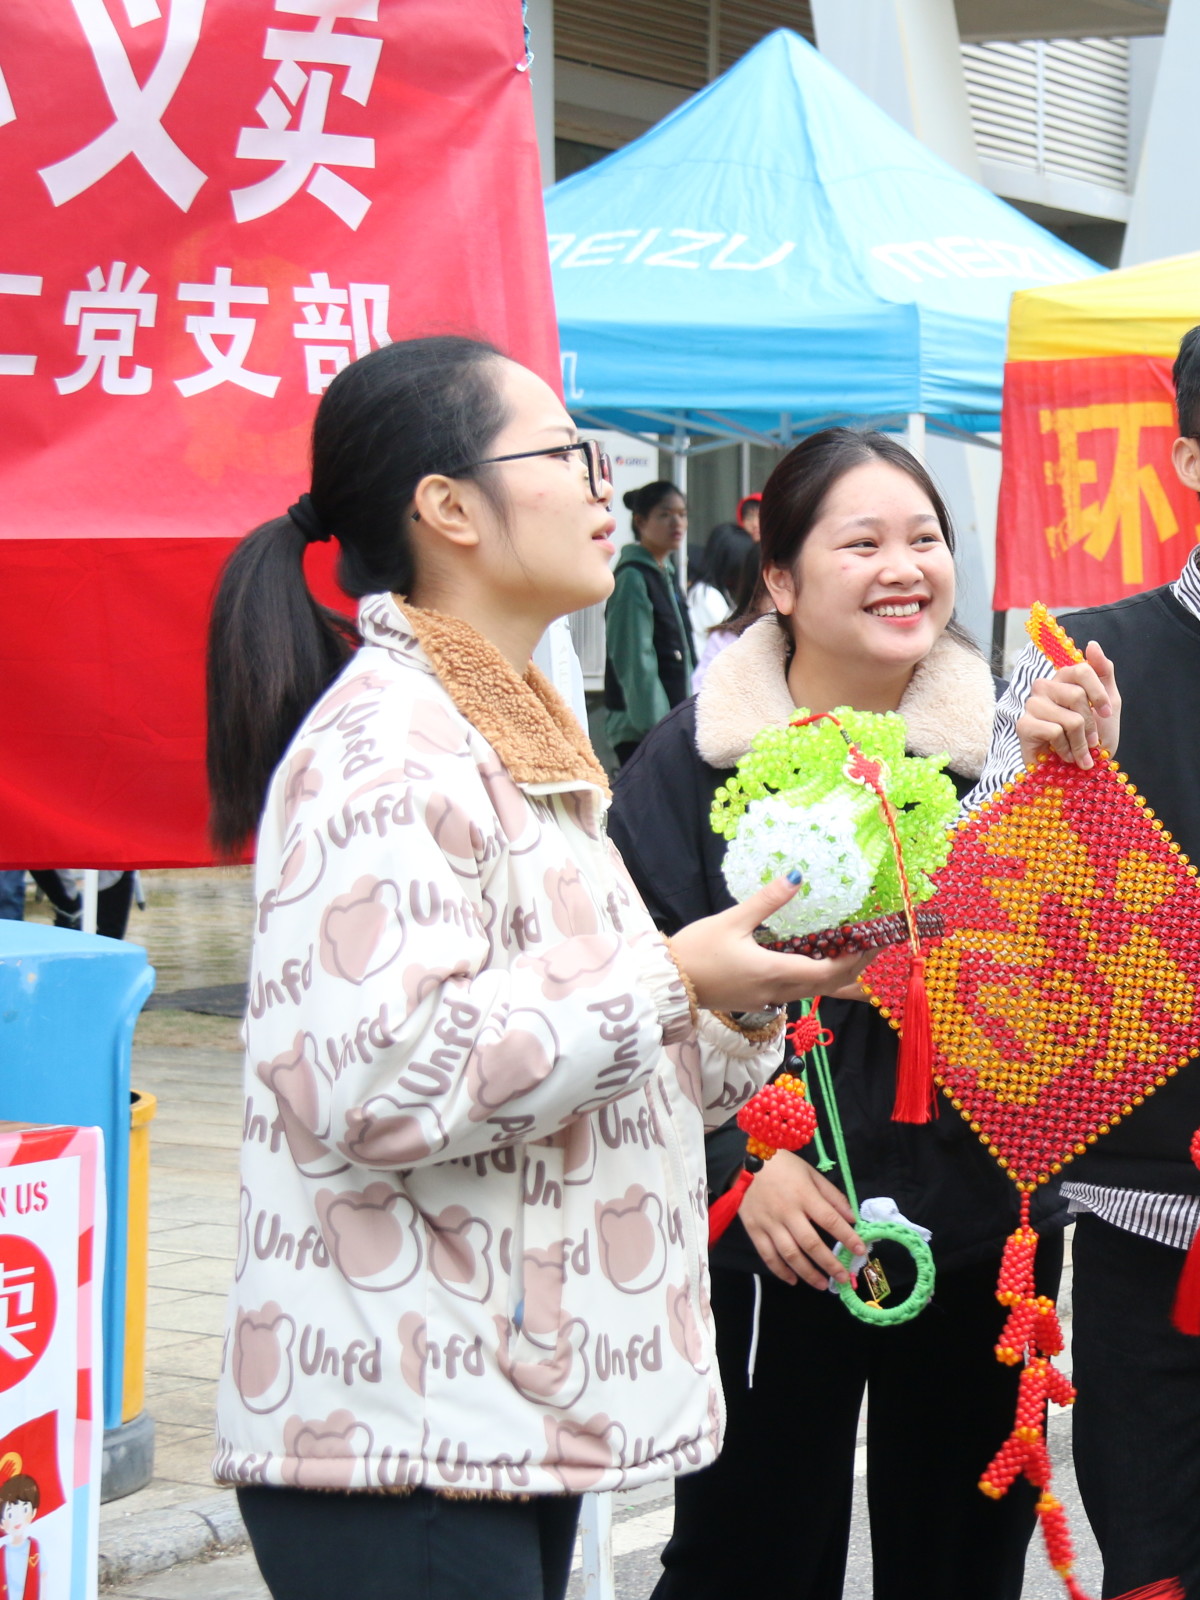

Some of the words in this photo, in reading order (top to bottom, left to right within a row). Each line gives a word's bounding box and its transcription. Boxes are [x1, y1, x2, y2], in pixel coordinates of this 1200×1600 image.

[0, 0, 383, 232] 义卖
[327, 785, 416, 849] Unfd
[251, 943, 314, 1019] Unfd
[398, 997, 482, 1097] Unfd
[16, 1181, 49, 1215] US
[299, 1323, 382, 1386] Unfd
[595, 1325, 663, 1382] Unfd
